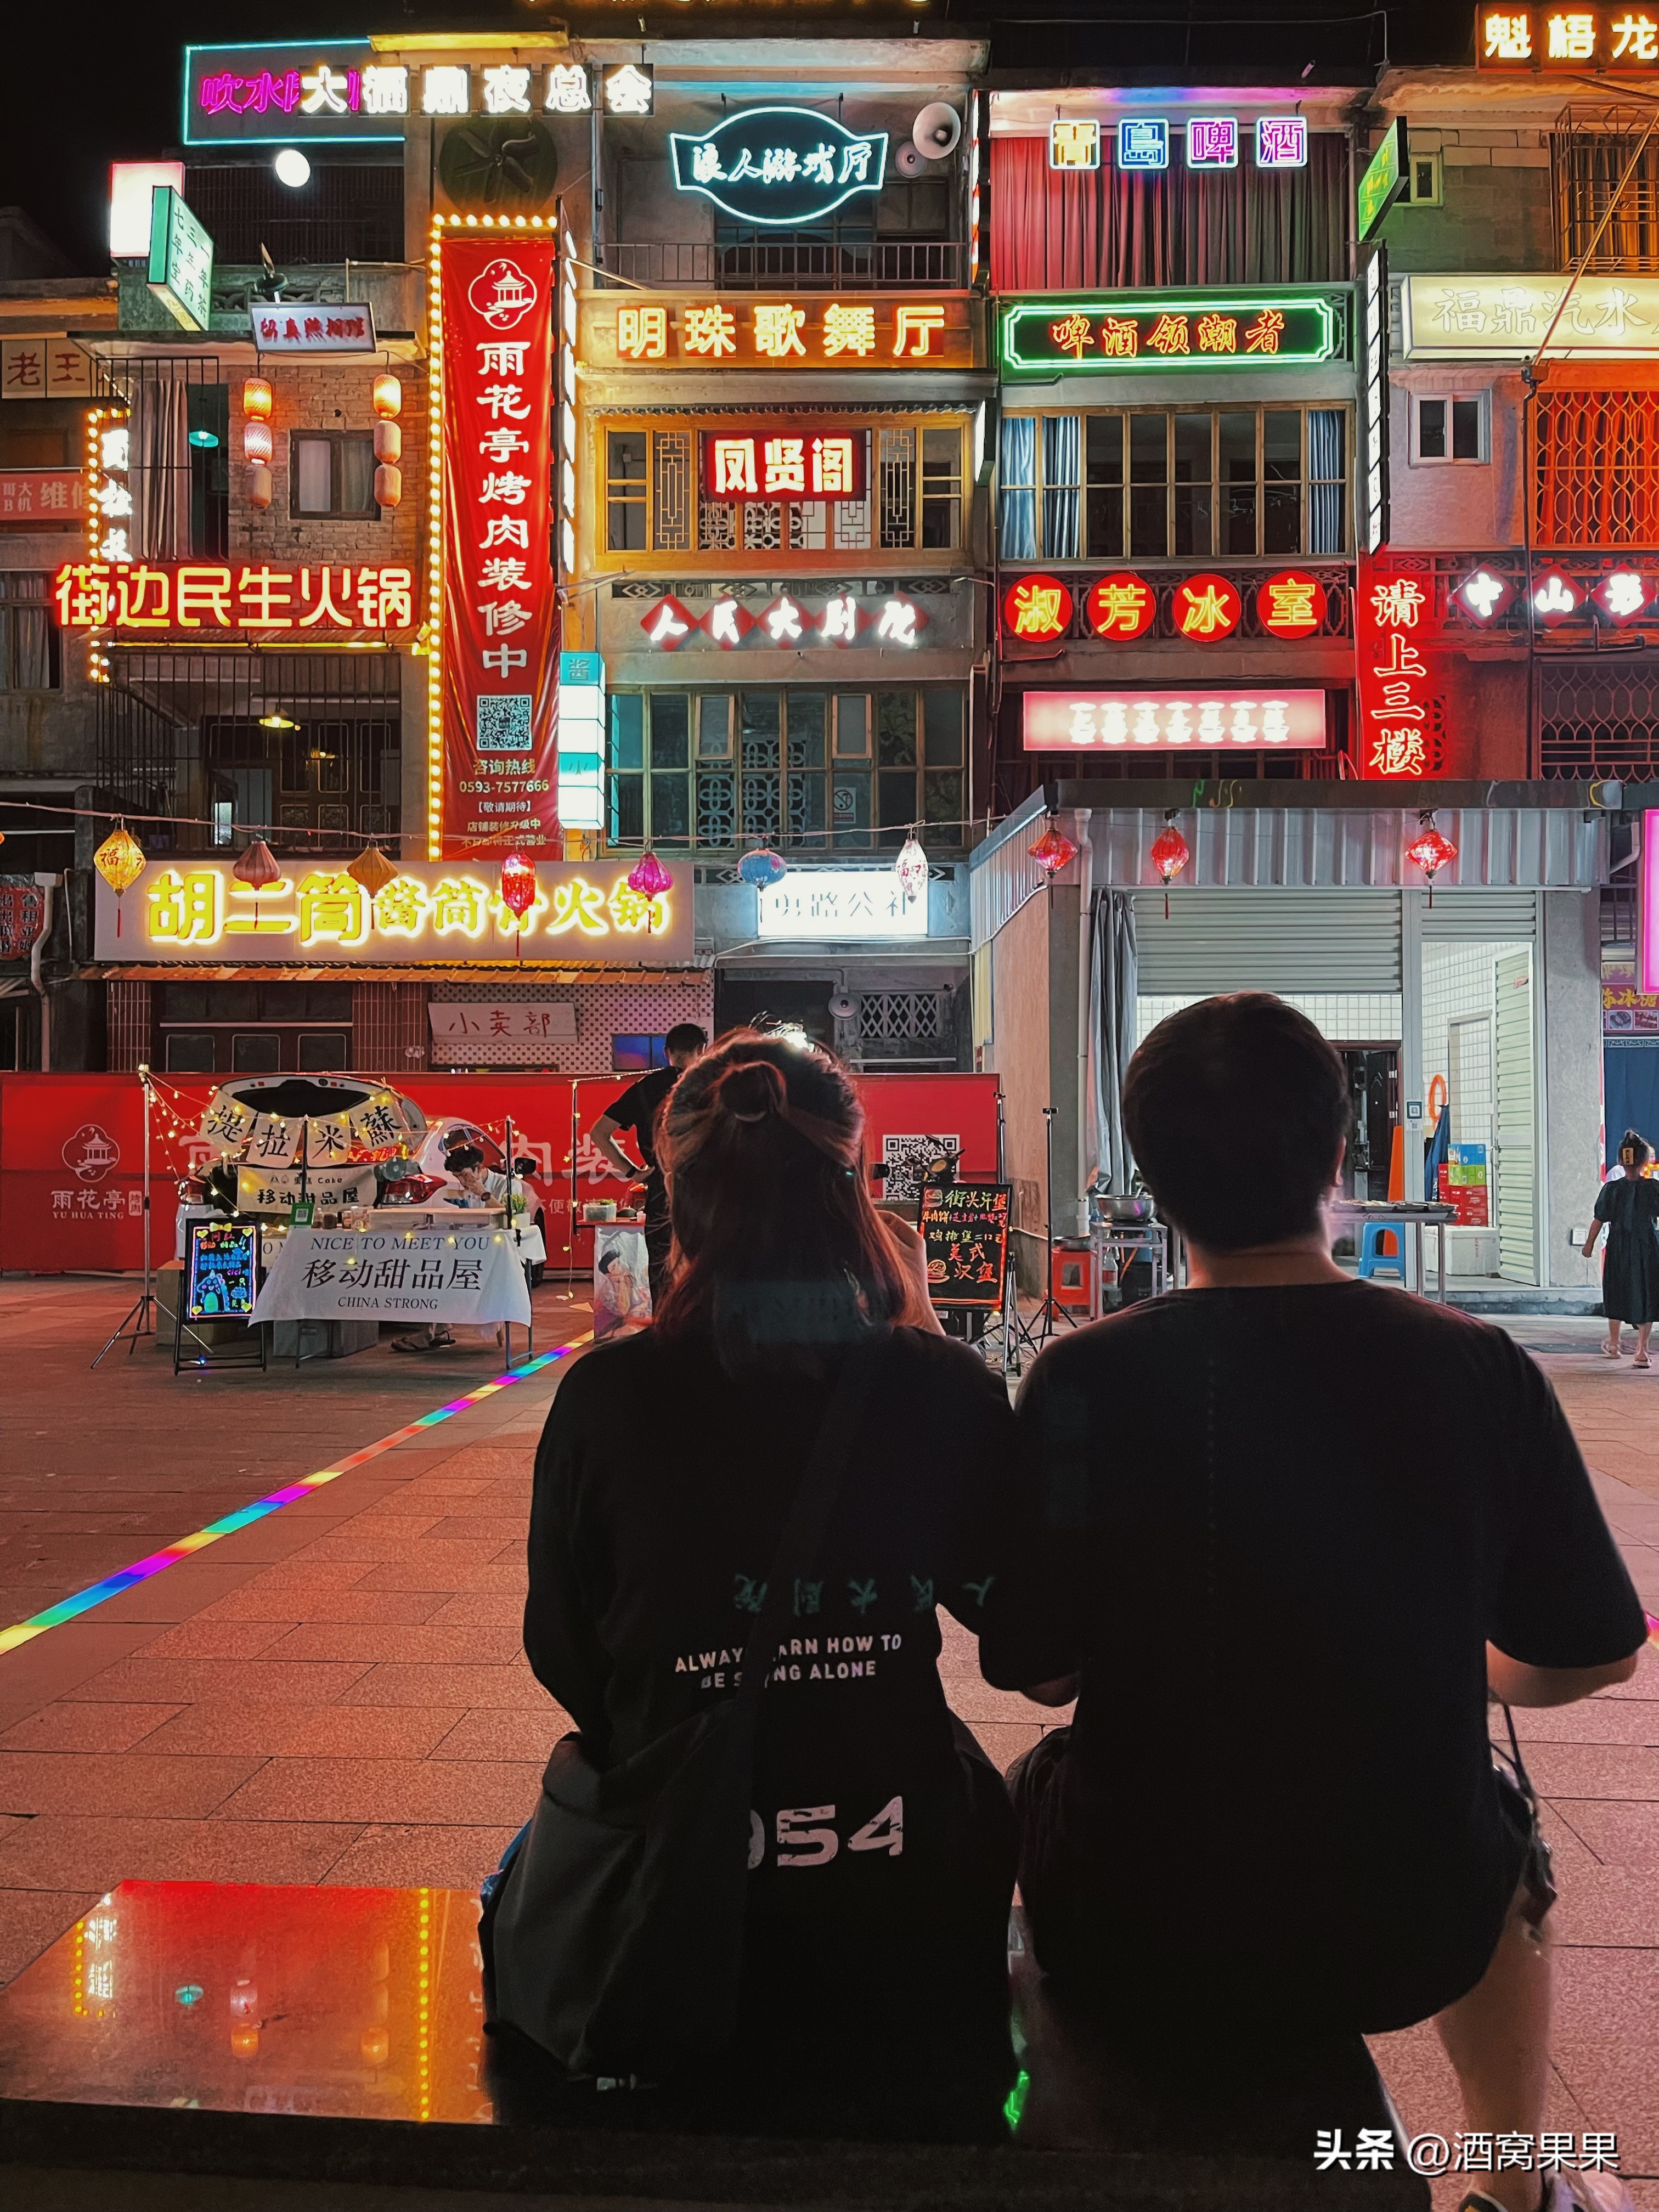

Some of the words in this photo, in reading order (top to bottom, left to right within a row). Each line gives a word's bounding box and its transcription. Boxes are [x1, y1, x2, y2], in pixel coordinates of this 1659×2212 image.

[1485, 14, 1658, 59] 魁梧龙
[301, 64, 652, 114] 大福鼎夜总会
[692, 141, 872, 185] 浪人游戏厅
[618, 303, 945, 358] 明珠歌舞厅
[1432, 286, 1658, 336] 福鼎汽水
[1053, 308, 1285, 360] 啤酒领潮者
[7, 351, 108, 386] 老王
[714, 437, 853, 494] 凤贤阁
[476, 341, 532, 679] 雨花亭烤肉装修中
[56, 563, 411, 628] 街边民生火锅
[1014, 578, 1318, 635] 淑芳冰室
[650, 595, 917, 645] 人民大剧院
[1369, 578, 1427, 776] 请上三楼
[459, 779, 549, 794] 0593-7577666
[473, 758, 536, 776] 咨询热线
[449, 1009, 550, 1038] 小卖部
[50, 1189, 126, 1210] 雨花亭
[53, 1211, 67, 1220] YU
[71, 1211, 94, 1220] HUA
[98, 1211, 124, 1220] TING
[311, 1237, 354, 1250] NICE
[360, 1237, 385, 1250] TO
[391, 1237, 445, 1250] MEET
[453, 1237, 490, 1250] YOU
[301, 1259, 483, 1291] 移动甜品屋
[337, 1296, 379, 1308] CHINA
[383, 1297, 438, 1310] STRONG
[675, 1647, 743, 1673] ALWAY
[774, 1638, 819, 1662] ARN
[827, 1635, 873, 1654] HOW
[881, 1634, 902, 1651] TO
[809, 1660, 876, 1680] ALONE
